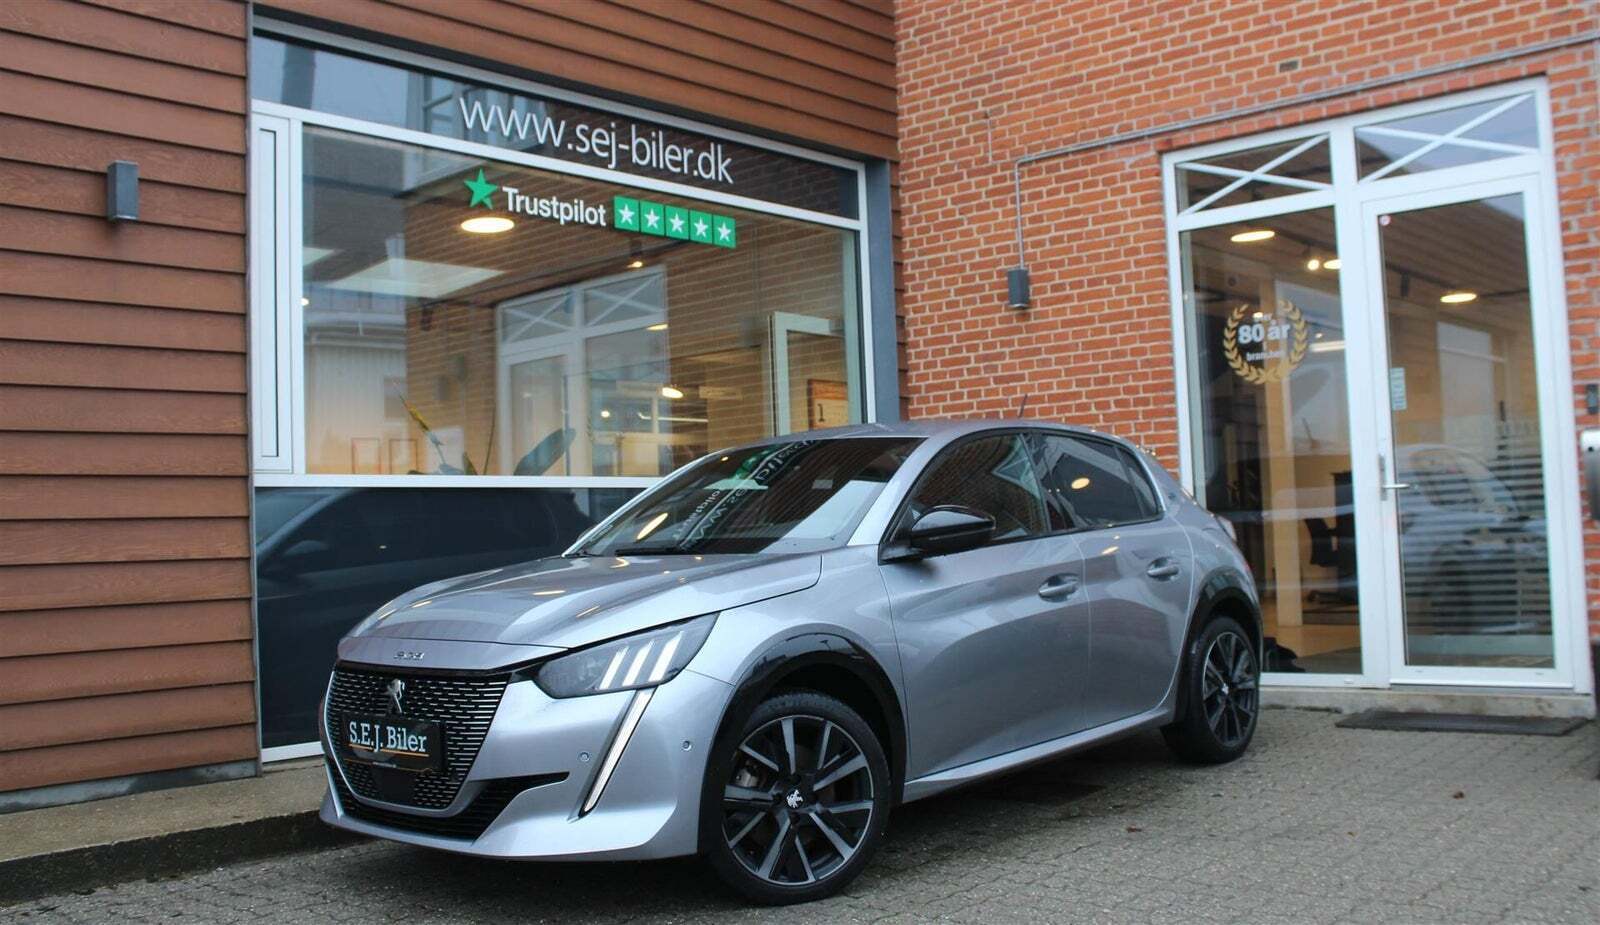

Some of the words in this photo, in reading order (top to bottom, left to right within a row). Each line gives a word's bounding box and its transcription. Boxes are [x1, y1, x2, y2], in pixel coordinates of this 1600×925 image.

[459, 97, 734, 184] www.sej-biler.dk
[502, 186, 607, 226] Trustpilot
[1238, 324, 1264, 344] 80
[1267, 320, 1291, 340] år
[349, 721, 384, 753] S.E.J.
[386, 725, 428, 752] Biler
